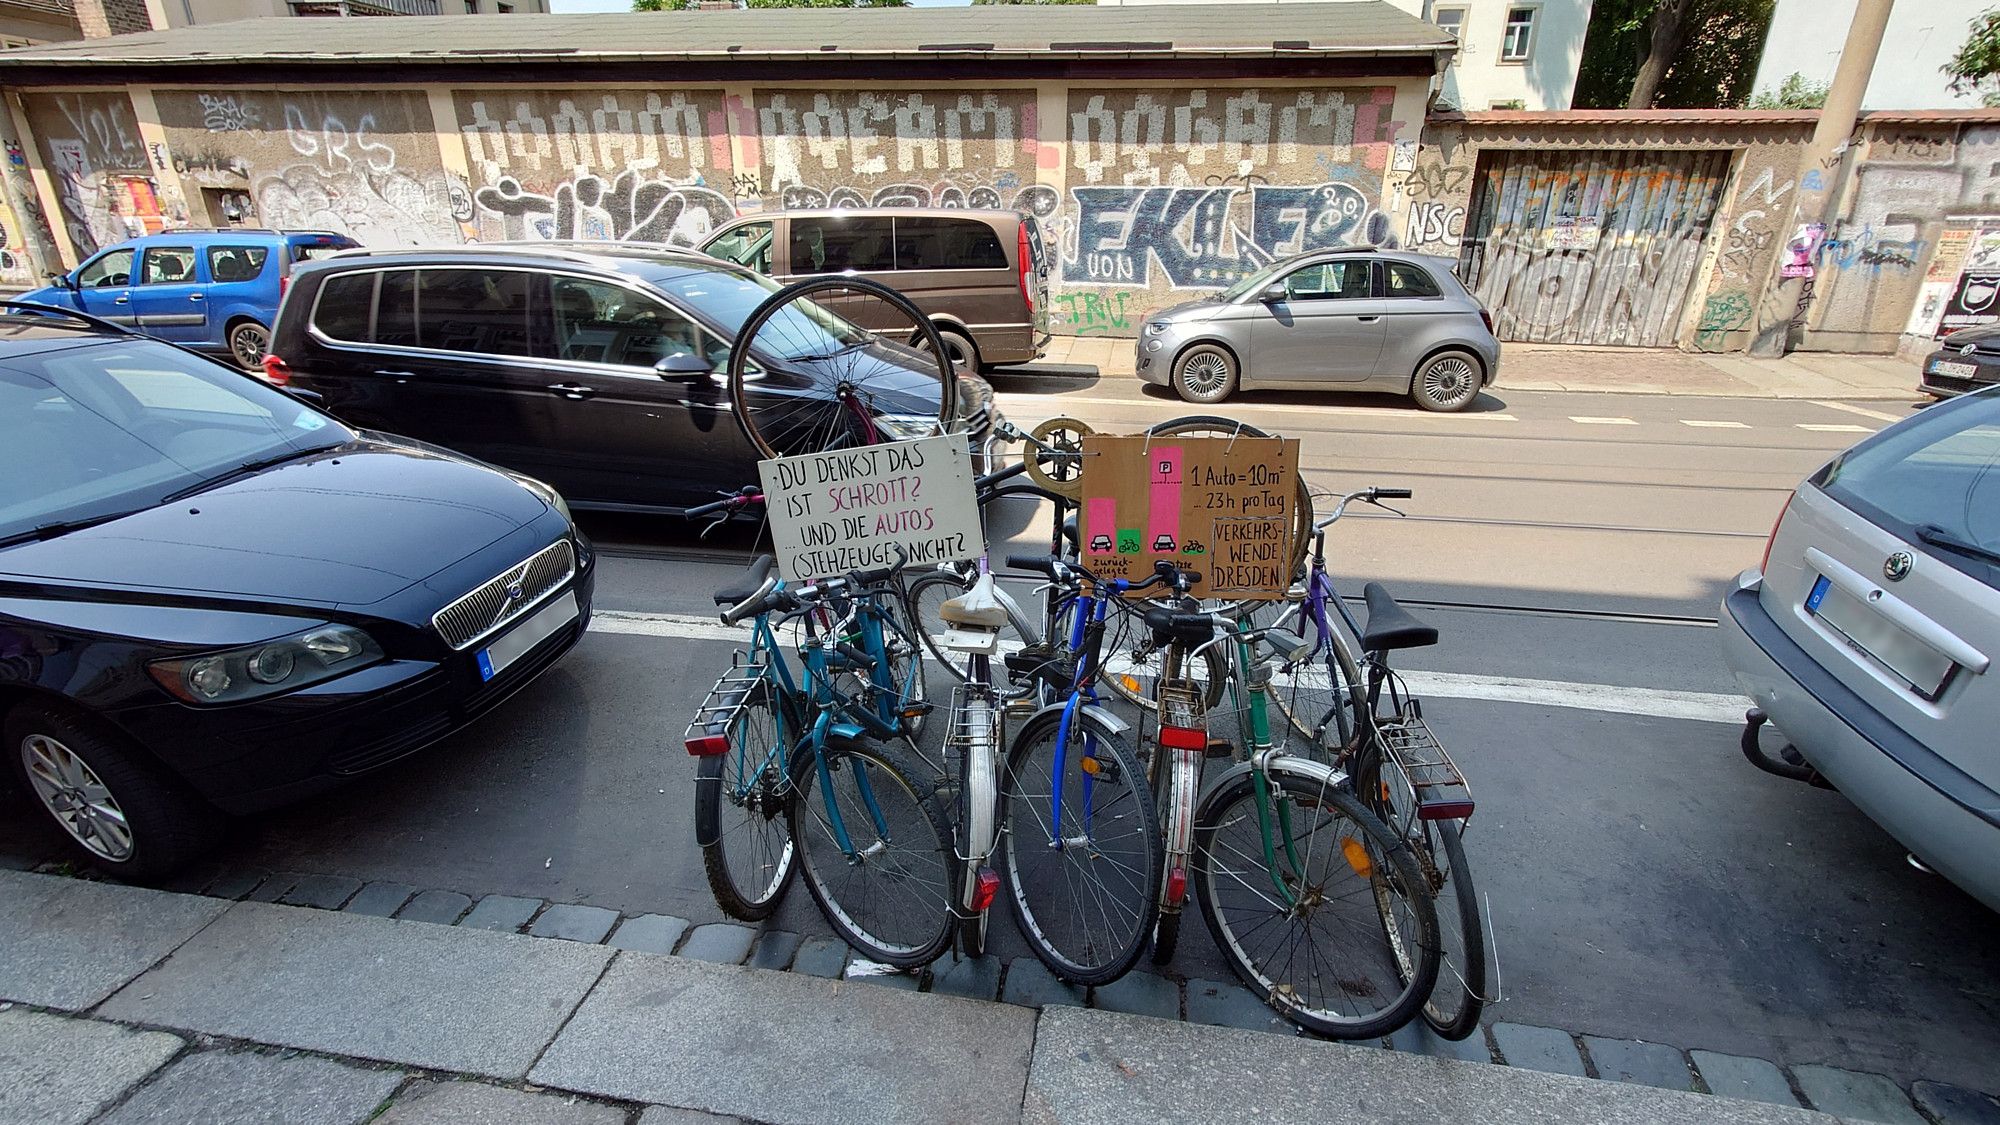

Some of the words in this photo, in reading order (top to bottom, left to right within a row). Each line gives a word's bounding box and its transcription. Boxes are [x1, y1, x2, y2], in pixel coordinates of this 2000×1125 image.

[1405, 201, 1464, 247] NSC
[777, 460, 807, 490] DU
[815, 450, 880, 483] DENKST
[886, 443, 924, 473] DAS
[1191, 465, 1201, 486] 1
[787, 492, 813, 518] IST
[829, 476, 921, 513] SCHROTT?
[801, 522, 836, 547] UND
[842, 515, 869, 541] DIE
[875, 508, 934, 536] AUTOS
[1215, 522, 1283, 541] VERKEHRS-
[909, 532, 966, 563] NICHT?
[1230, 543, 1278, 563] WENDE
[1215, 565, 1280, 587] DRESDEN
